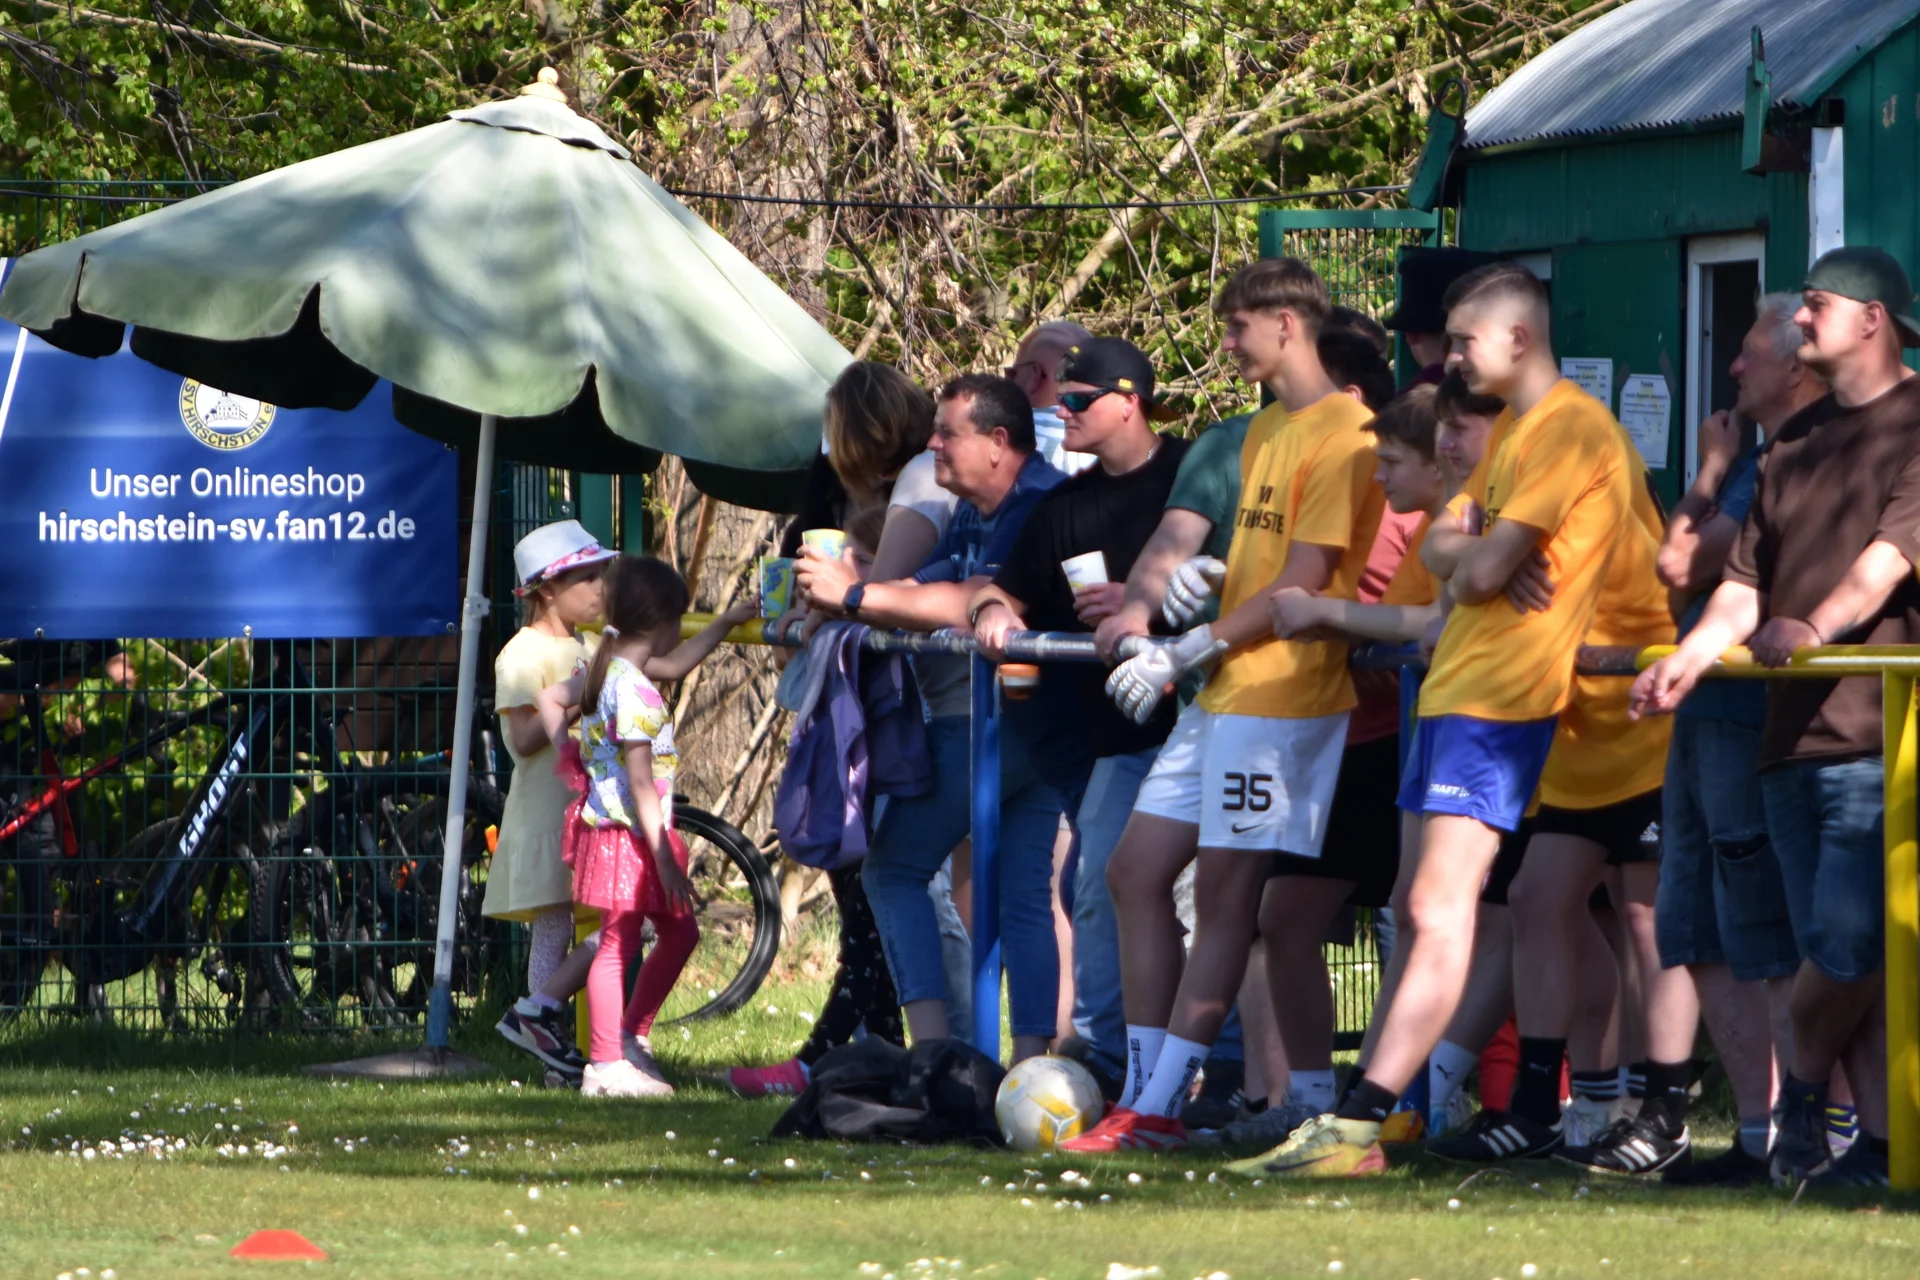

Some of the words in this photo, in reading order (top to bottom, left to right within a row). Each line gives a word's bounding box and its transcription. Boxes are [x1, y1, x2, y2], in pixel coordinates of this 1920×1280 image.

[183, 383, 196, 404] SV
[184, 407, 268, 447] HIRSCHSTEIN
[90, 468, 181, 496] Unser
[190, 467, 365, 502] Onlineshop
[39, 510, 416, 541] hirschstein-sv.fan12.de
[179, 732, 247, 858] GHOST
[1222, 771, 1273, 812] 35
